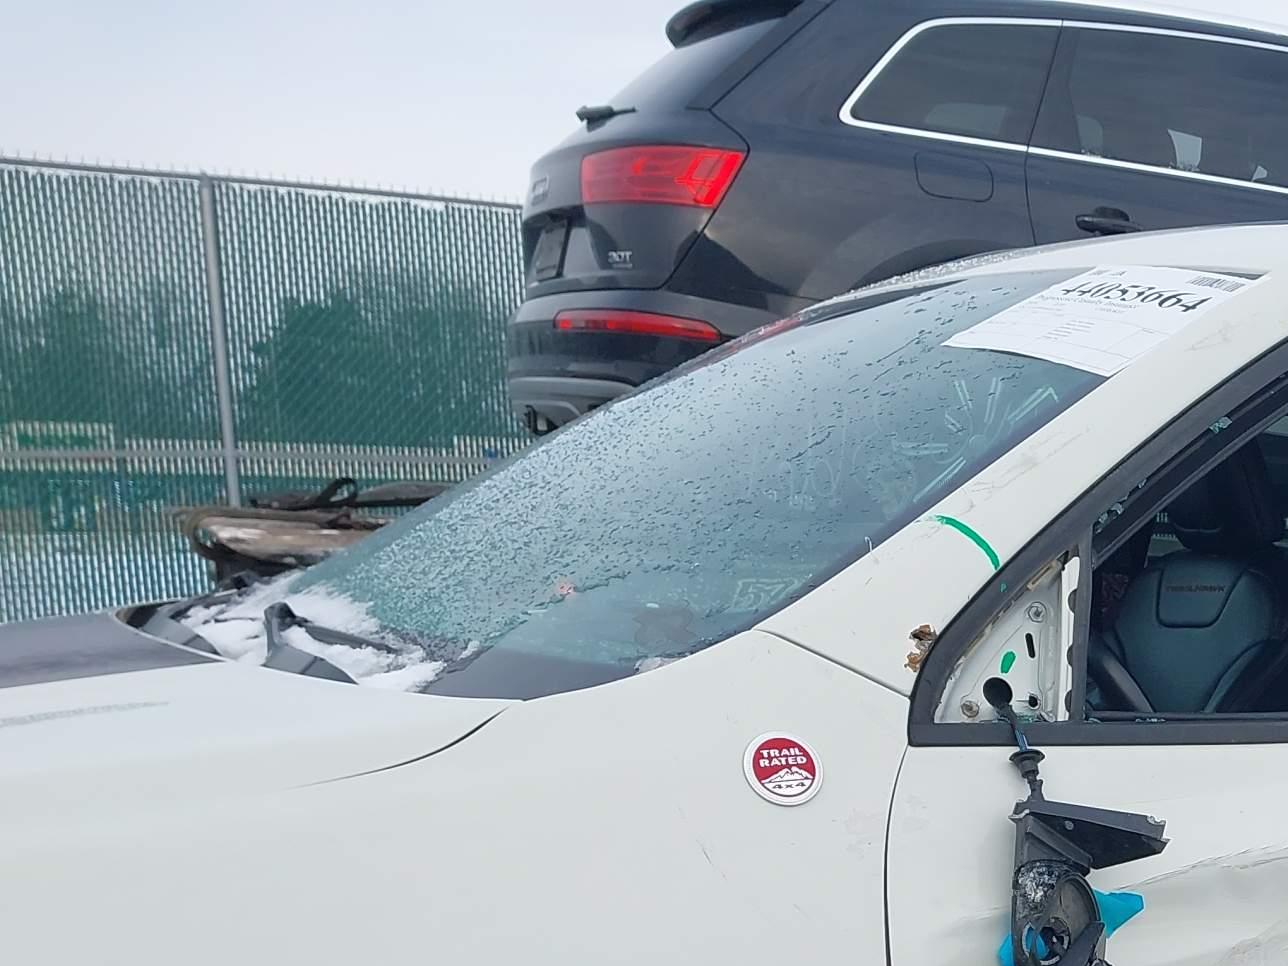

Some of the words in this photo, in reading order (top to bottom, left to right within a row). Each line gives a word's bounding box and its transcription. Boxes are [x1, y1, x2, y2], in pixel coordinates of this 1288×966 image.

[1061, 281, 1214, 313] 44053664
[759, 747, 804, 758] TRAIL
[758, 756, 808, 767] RATED
